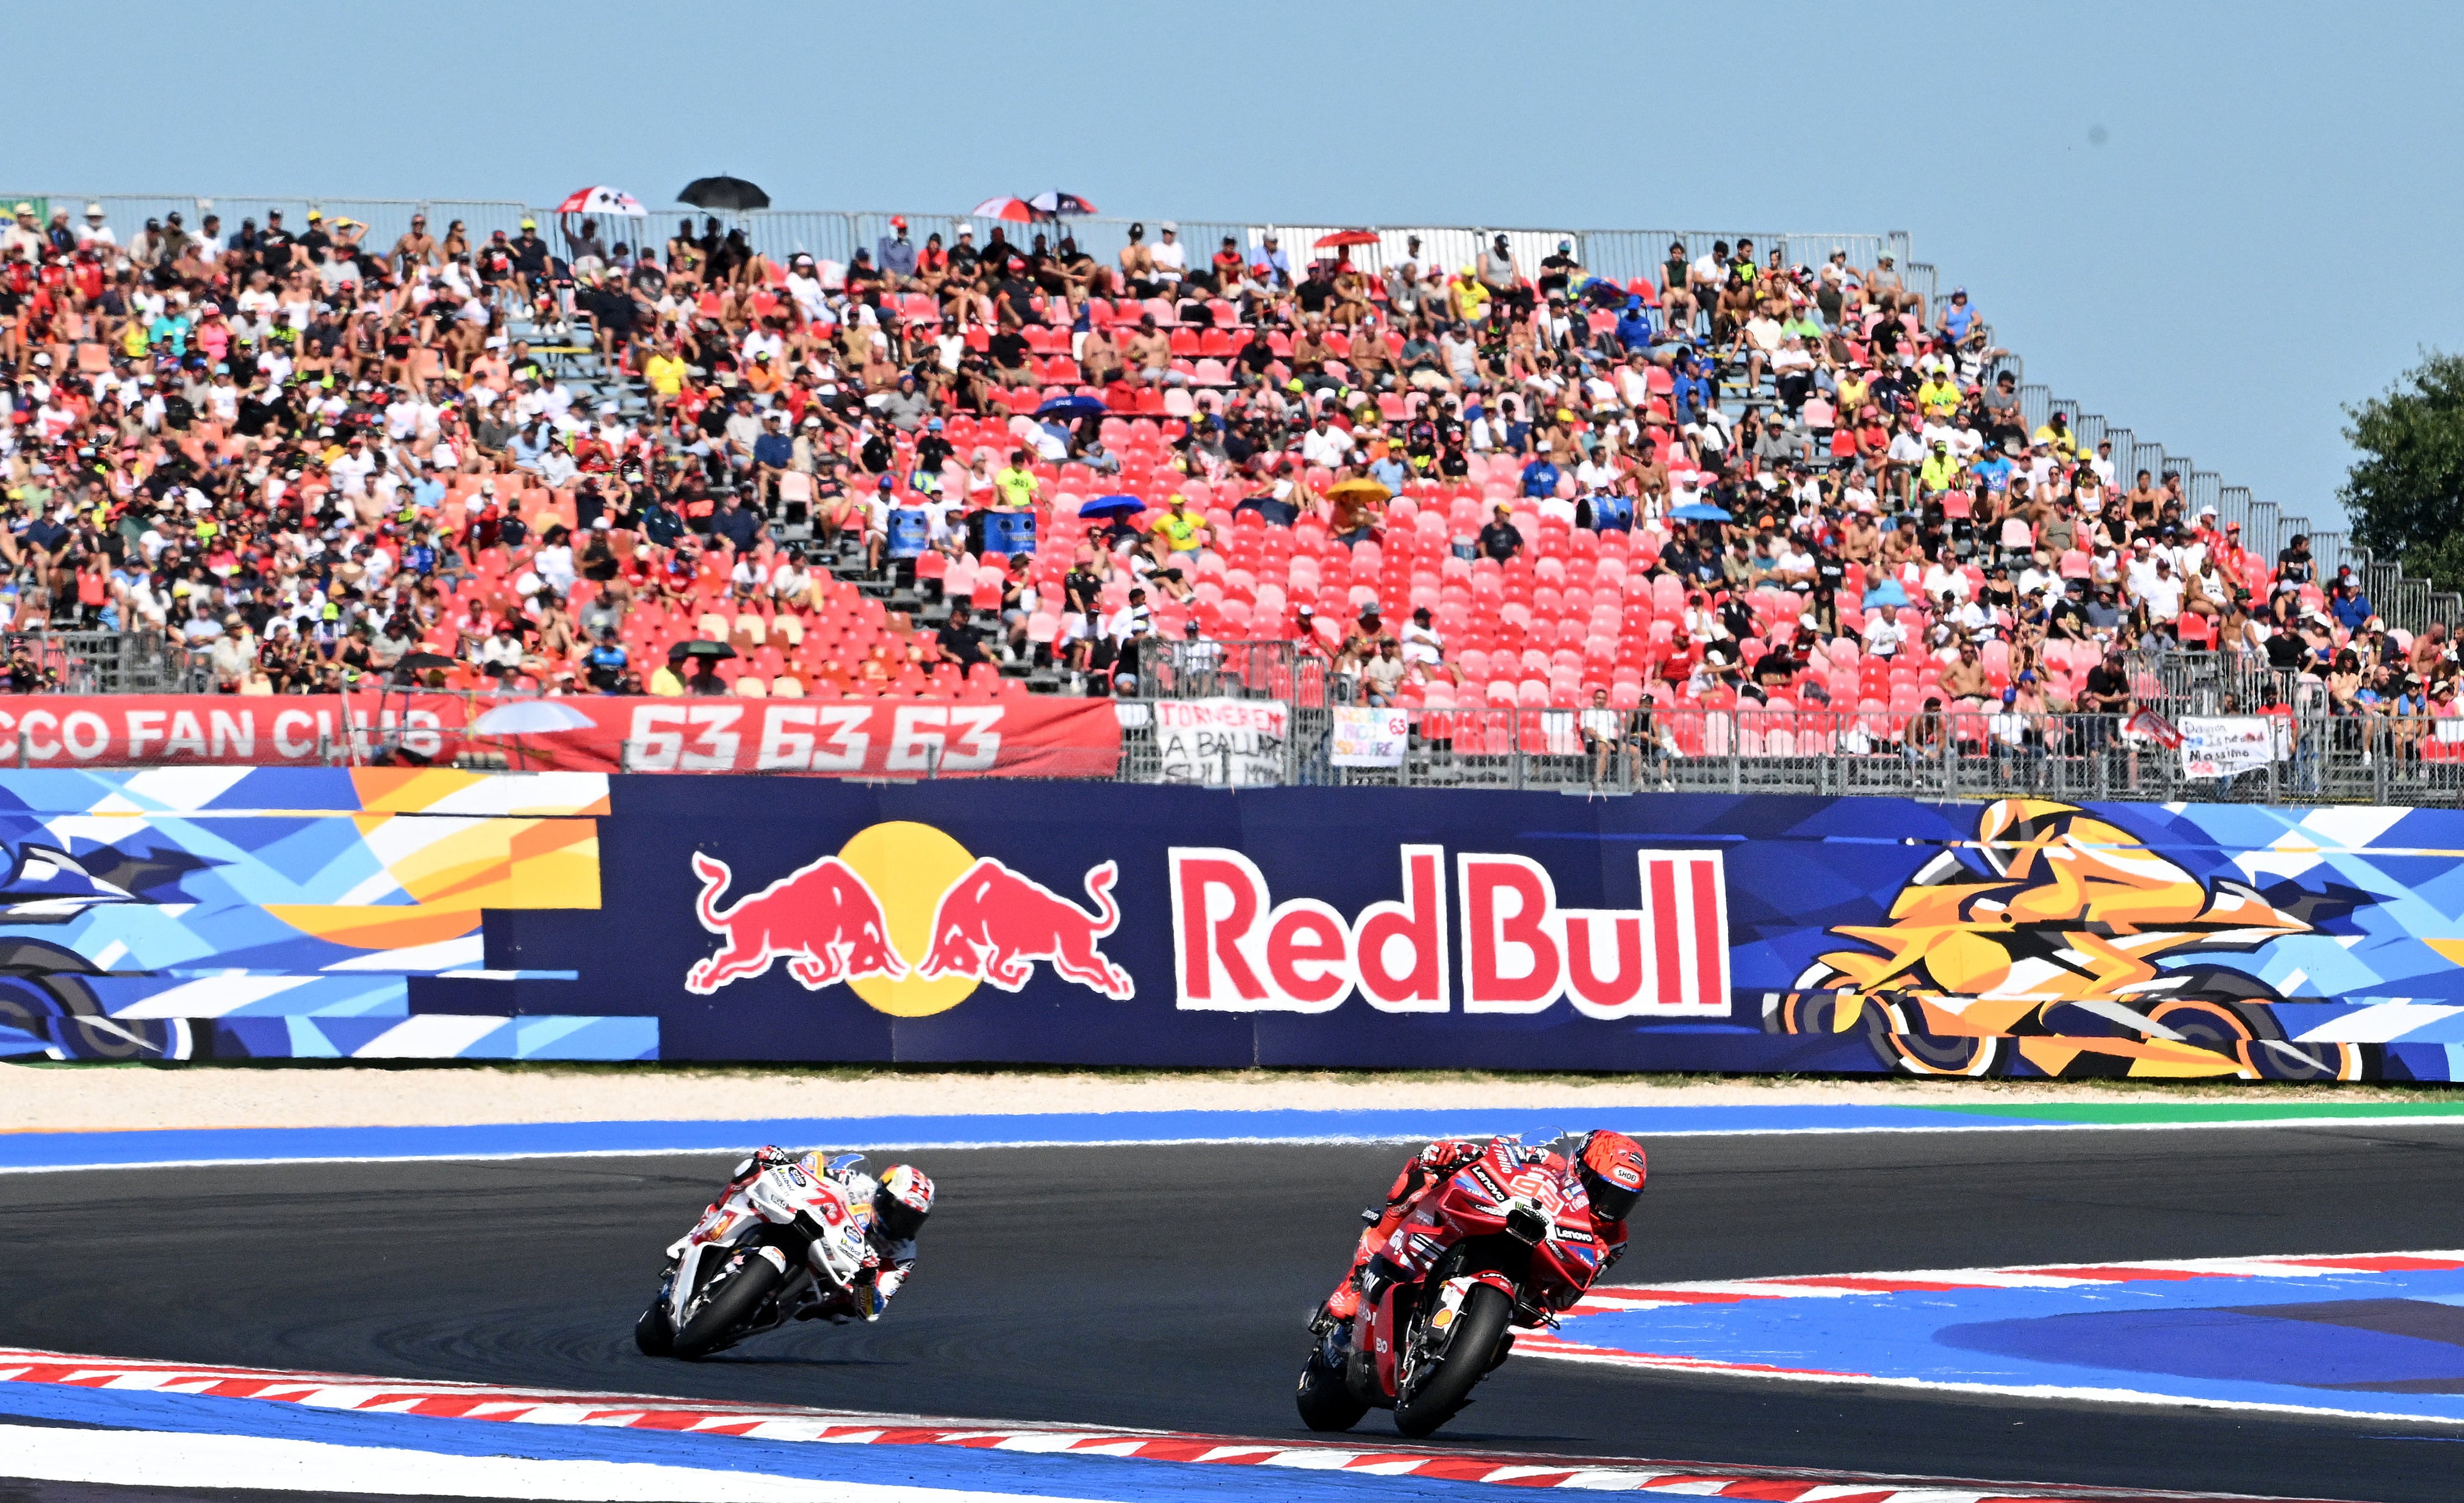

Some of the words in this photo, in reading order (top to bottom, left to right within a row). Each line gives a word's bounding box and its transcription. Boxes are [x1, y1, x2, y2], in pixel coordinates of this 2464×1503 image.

[128, 710, 253, 759] FAN
[628, 705, 744, 770] 63
[757, 705, 873, 770] 63
[885, 705, 1004, 771] 63
[1389, 718, 1407, 736] 63
[1165, 735, 1187, 759] A
[1175, 849, 1444, 1007] Red
[1463, 854, 1727, 1013] Bull
[1466, 1186, 1483, 1198] TIM
[1471, 1166, 1505, 1201] Lenovo
[1556, 1226, 1593, 1242] Lenovo
